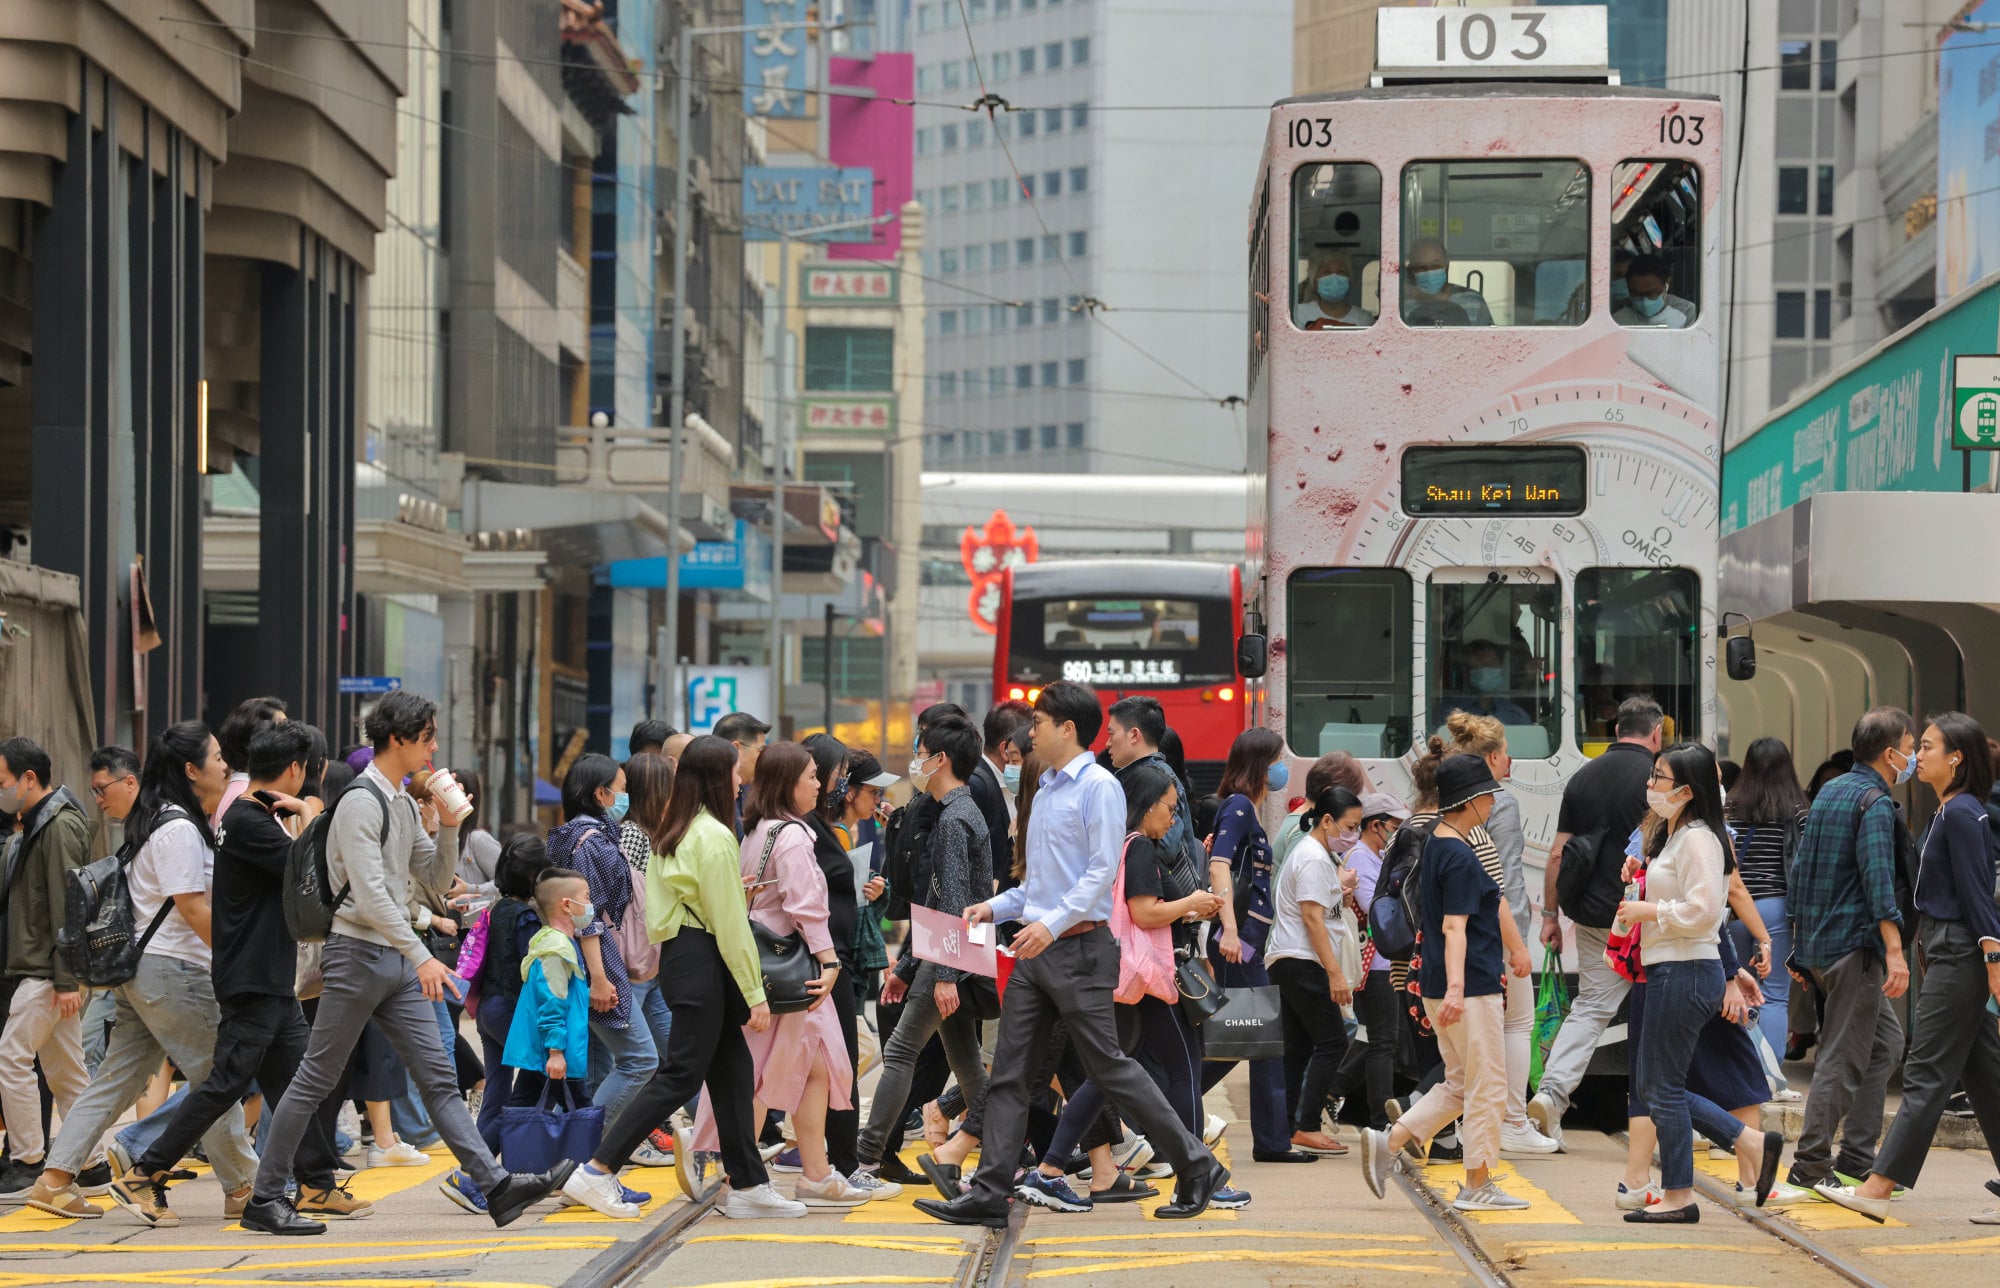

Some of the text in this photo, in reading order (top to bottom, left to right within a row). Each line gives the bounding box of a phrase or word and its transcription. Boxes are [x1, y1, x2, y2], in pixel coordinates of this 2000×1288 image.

[1436, 13, 1547, 60] 103
[1289, 118, 1332, 148] 103
[1660, 115, 1705, 146] 103
[751, 180, 803, 203] YAT
[1508, 418, 1528, 434] 70
[1604, 408, 1624, 422] 65
[1427, 485, 1560, 500] Shau Kei Wan
[1514, 532, 1536, 554] 45
[1622, 530, 1680, 568] OMEG
[1063, 661, 1092, 682] 960
[1225, 1019, 1263, 1027] CHANEL
